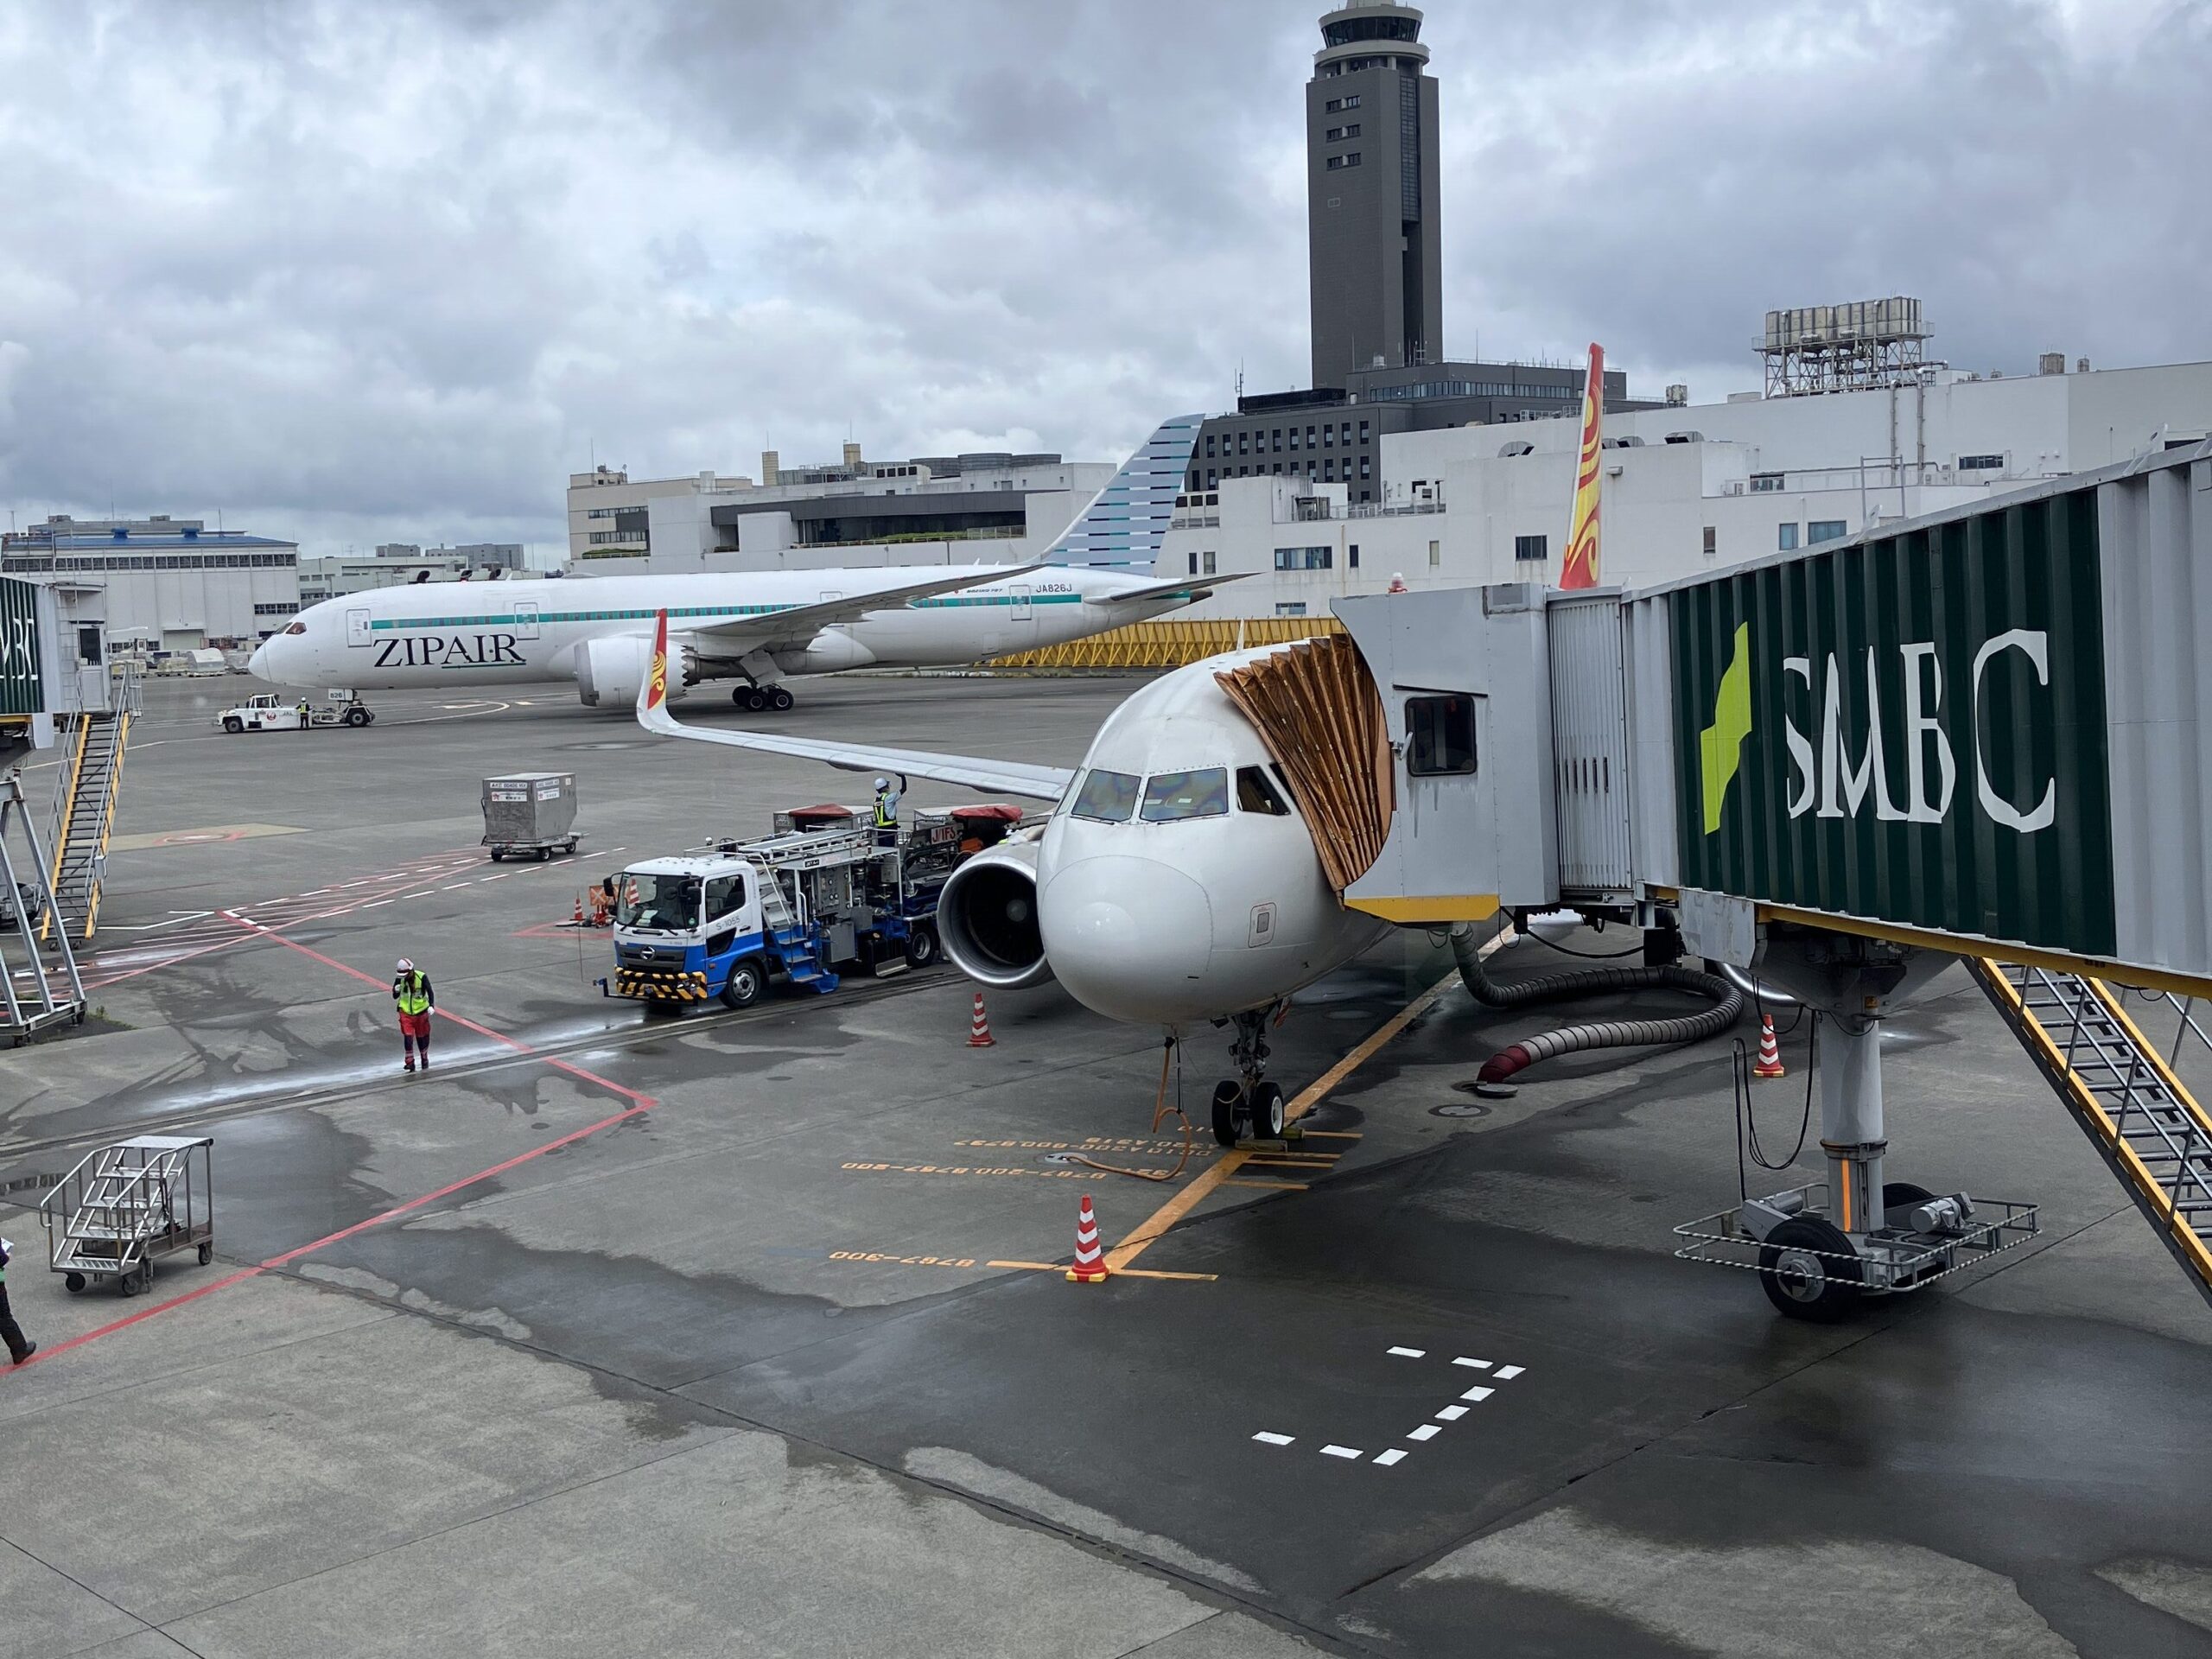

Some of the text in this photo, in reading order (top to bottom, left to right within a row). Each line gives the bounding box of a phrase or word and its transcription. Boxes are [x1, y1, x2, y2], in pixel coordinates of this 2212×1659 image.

[1036, 584, 1072, 593] JA826J
[372, 633, 527, 667] ZIPAIR
[1783, 628, 2055, 833] SMBC
